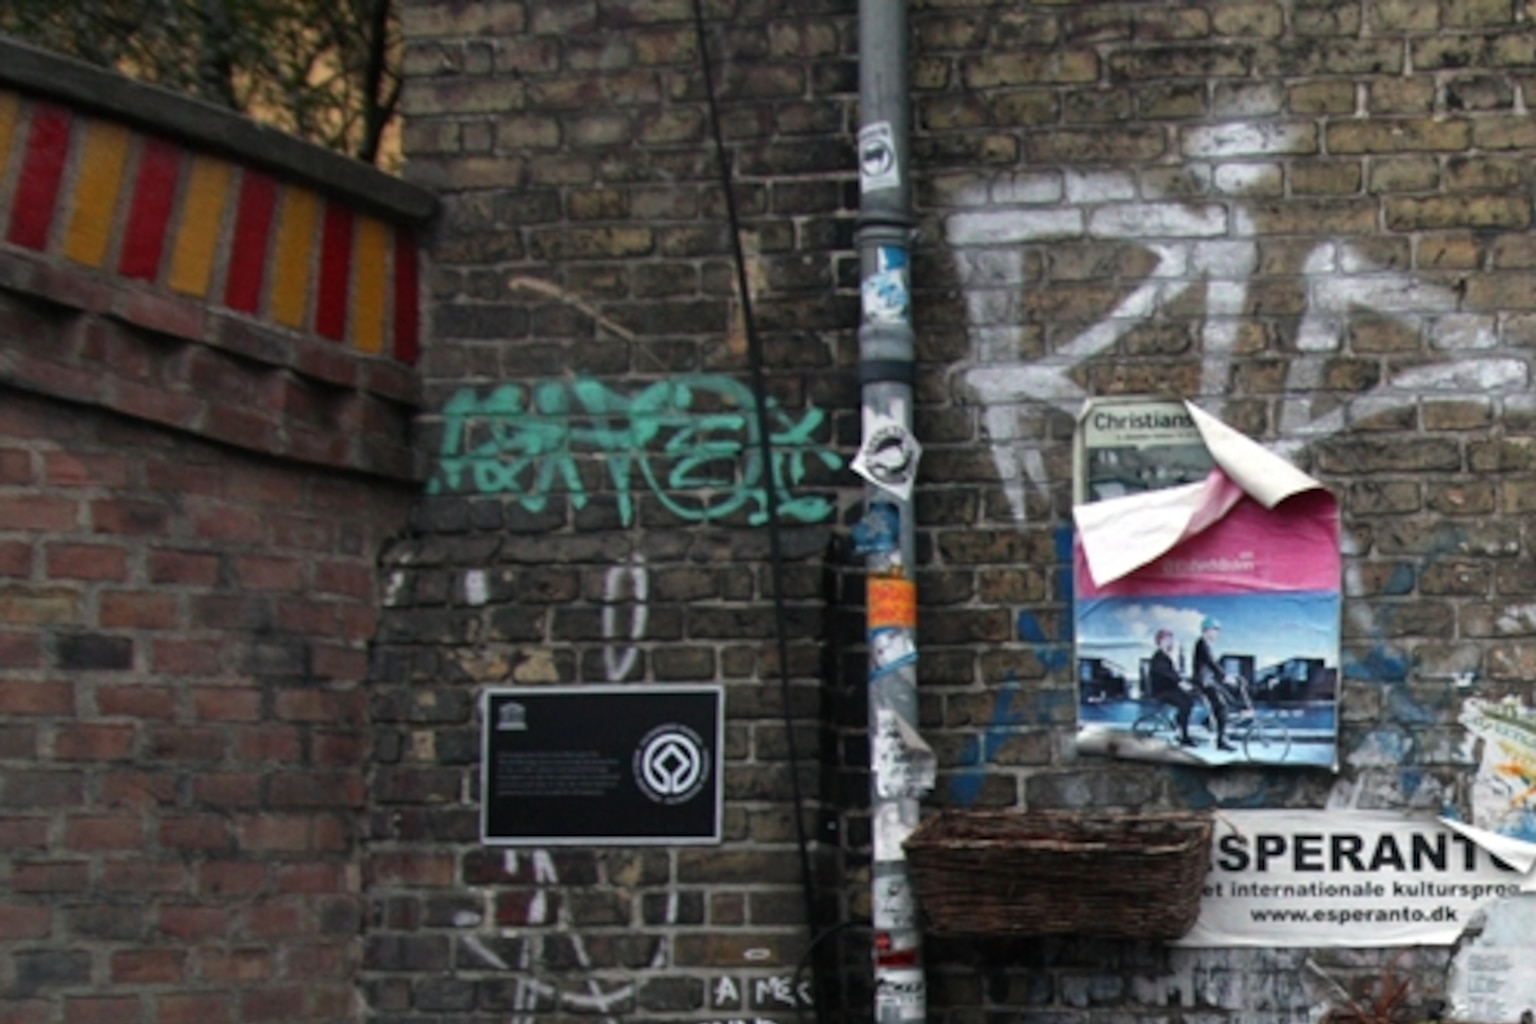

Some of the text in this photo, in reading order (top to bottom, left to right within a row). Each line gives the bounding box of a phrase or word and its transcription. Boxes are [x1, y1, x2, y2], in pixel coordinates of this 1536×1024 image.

[1208, 833, 1519, 873] SPERANT
[1230, 880, 1386, 898] internationale
[1249, 905, 1459, 923] www.esperanto.dk
